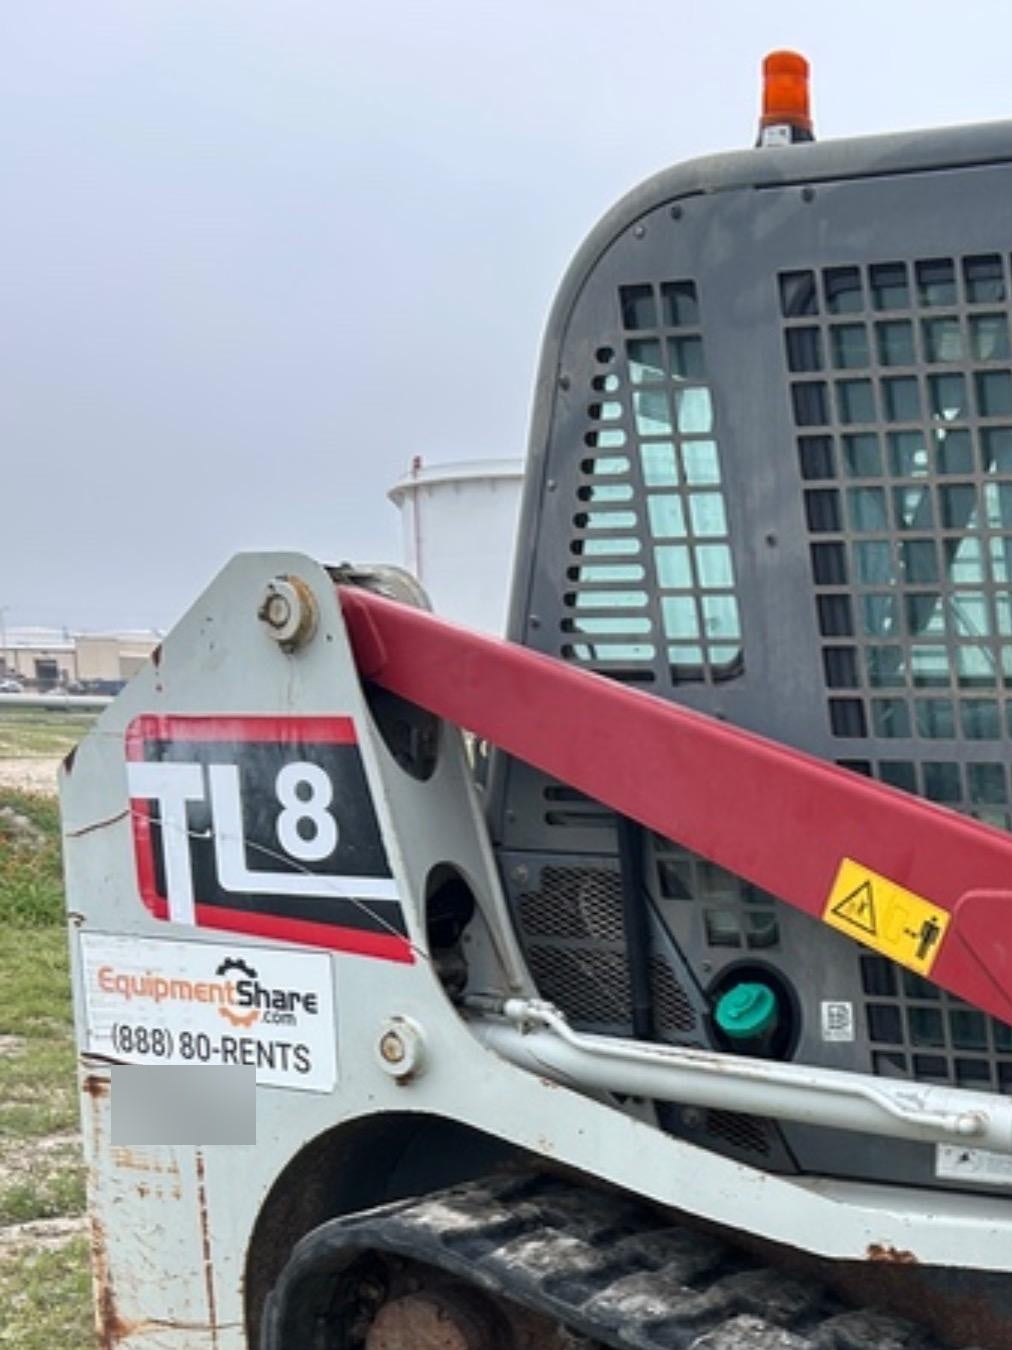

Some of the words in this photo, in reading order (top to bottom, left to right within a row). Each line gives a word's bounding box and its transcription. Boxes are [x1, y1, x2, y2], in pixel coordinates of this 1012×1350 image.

[126, 761, 400, 926] TL8
[97, 965, 318, 1014] EquipmentShare
[112, 1022, 173, 1059] (888)
[179, 1032, 311, 1074] 80-RENTS
